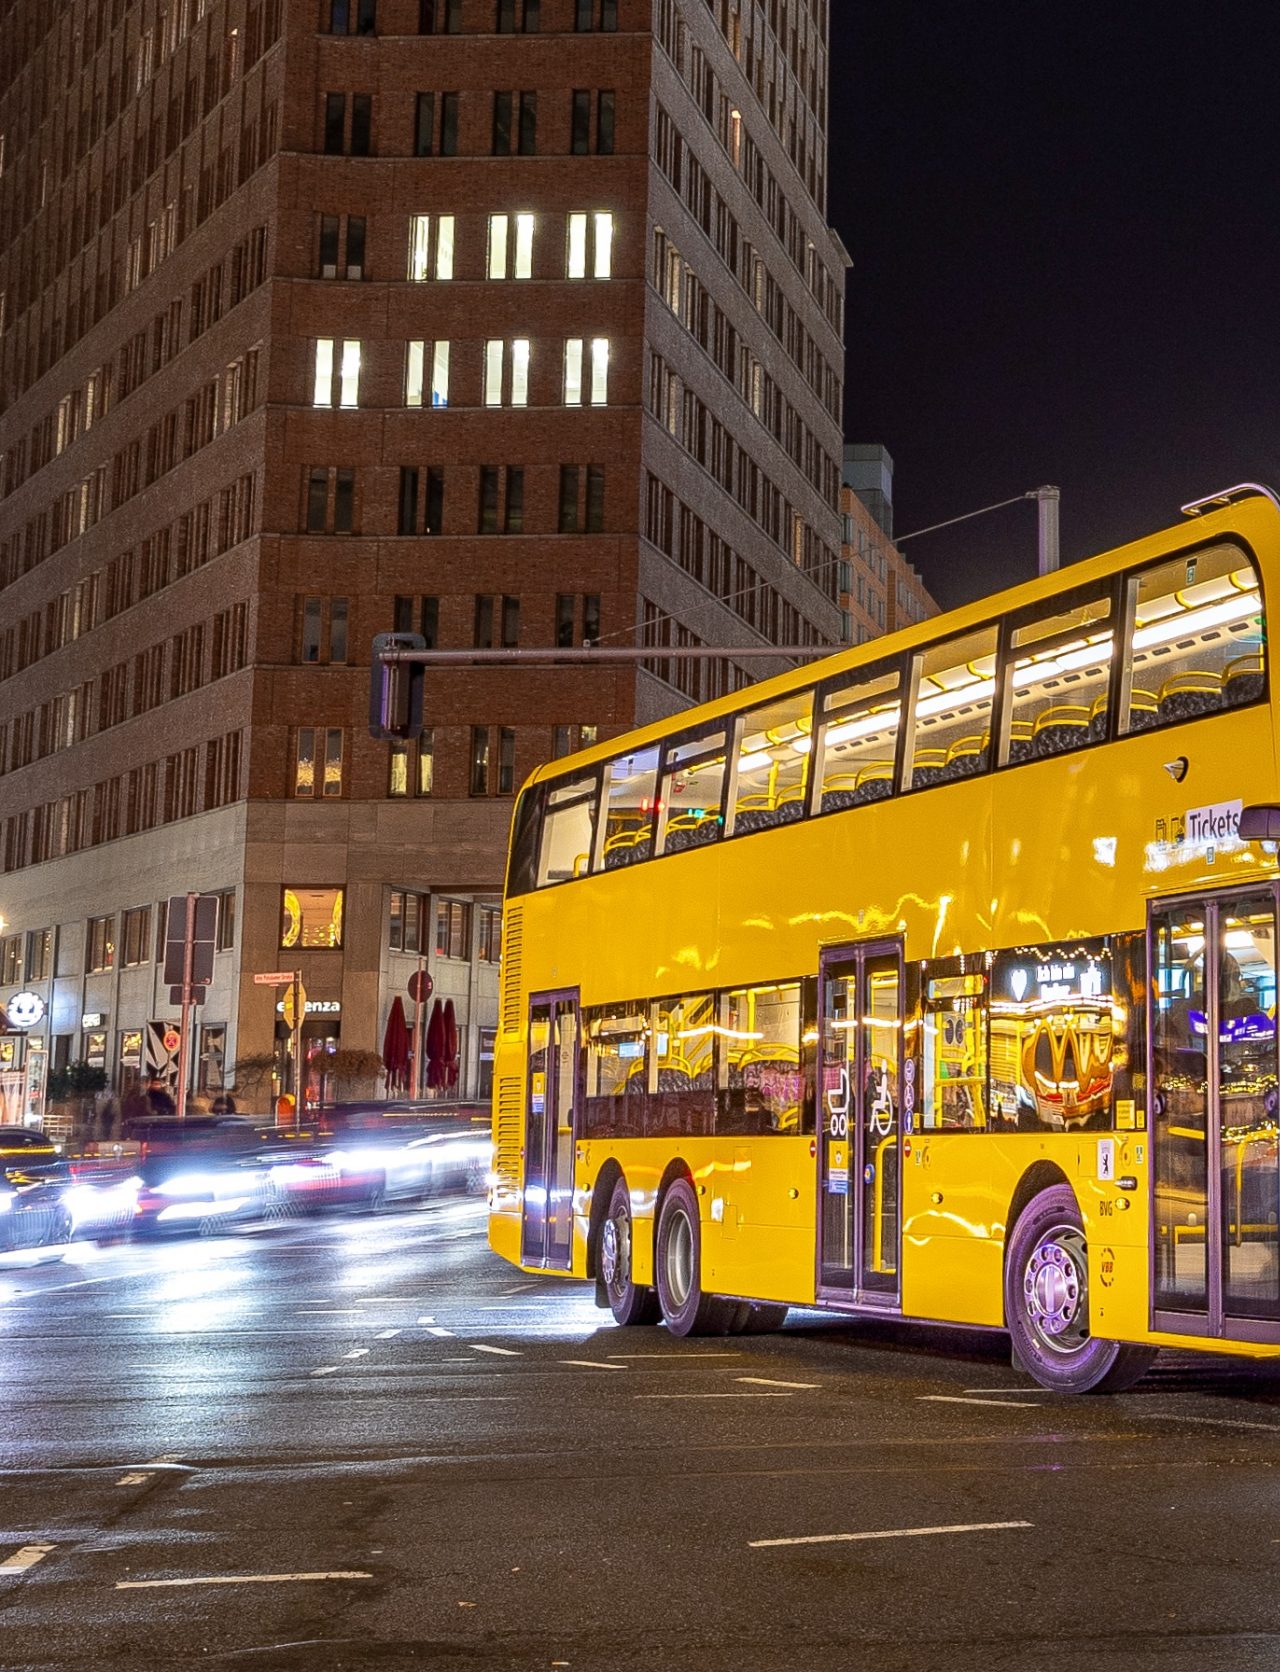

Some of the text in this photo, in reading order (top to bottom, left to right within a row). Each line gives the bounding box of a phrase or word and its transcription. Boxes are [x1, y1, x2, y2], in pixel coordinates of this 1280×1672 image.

[1189, 808, 1240, 843] Tickets
[276, 1001, 340, 1012] eenza
[1100, 1201, 1113, 1217] BVG
